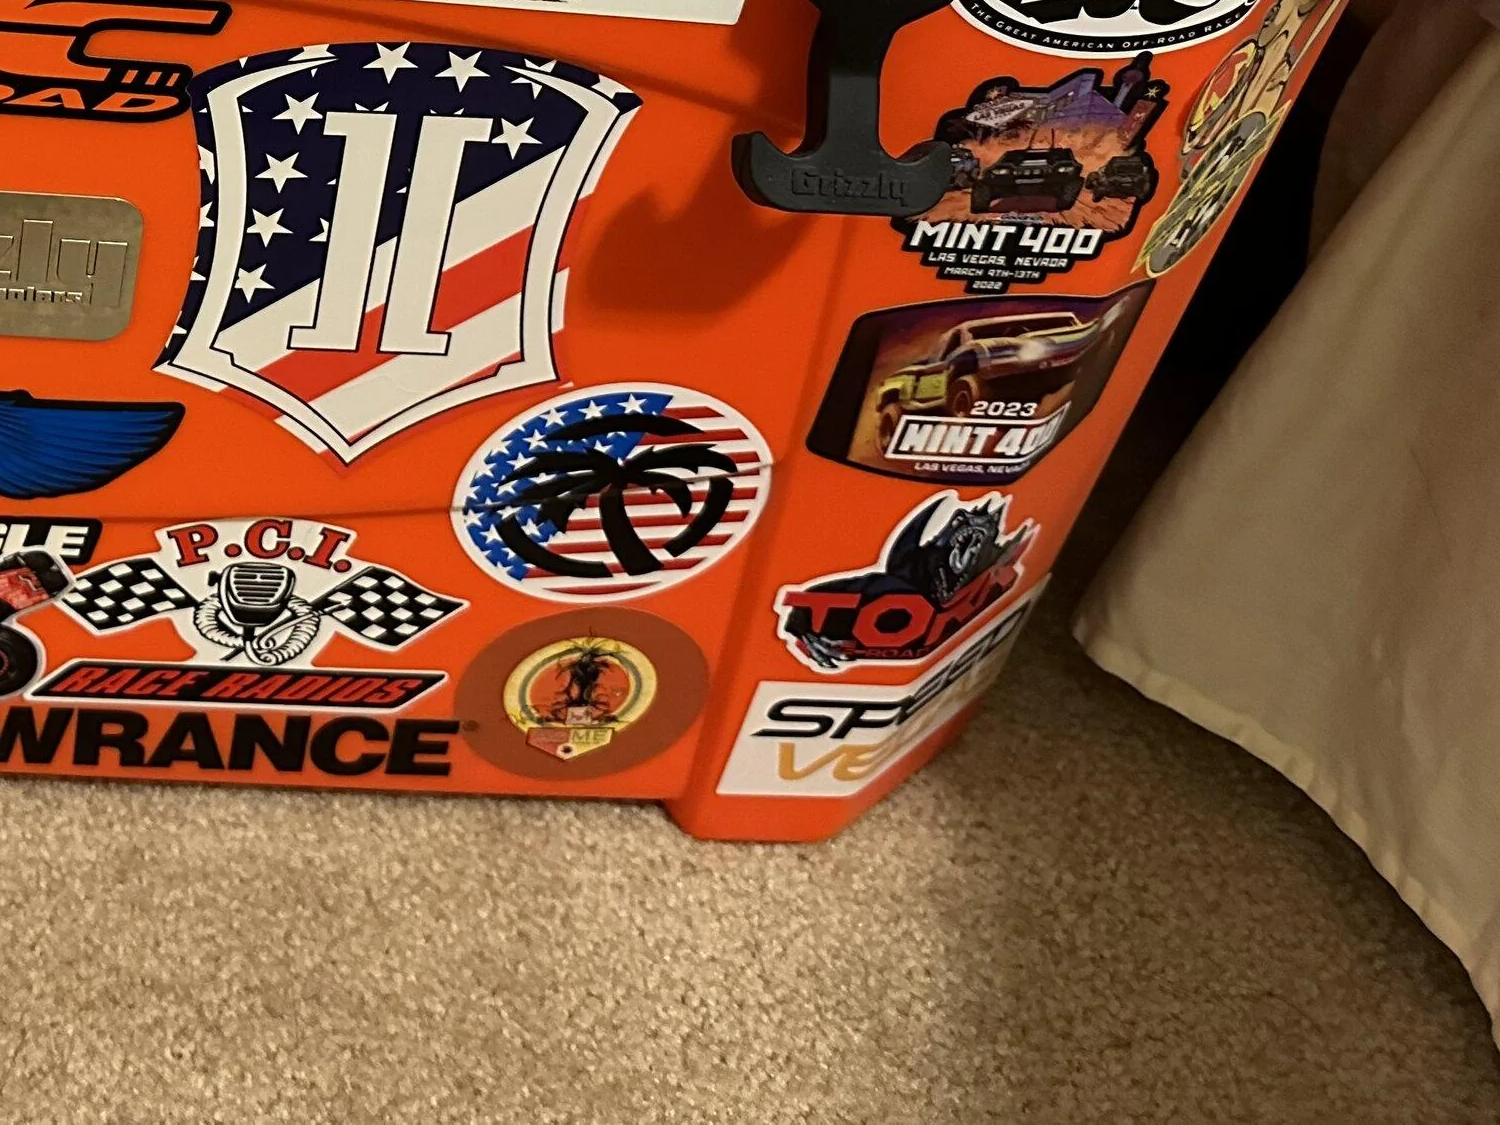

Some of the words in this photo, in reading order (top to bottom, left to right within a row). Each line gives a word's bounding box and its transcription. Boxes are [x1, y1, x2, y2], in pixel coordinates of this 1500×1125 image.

[909, 220, 1017, 252] MINT
[1018, 226, 1103, 255] 400
[928, 252, 958, 263] LAS
[1014, 256, 1068, 268] NEVADA
[944, 266, 984, 277] MARCH
[972, 280, 1004, 290] 2022
[969, 400, 1038, 417] 2023
[898, 423, 998, 456] MINT
[913, 462, 939, 472] LAS
[166, 518, 353, 574] P.C.I.
[52, 666, 197, 696] RACE
[201, 671, 423, 704] RADIOS
